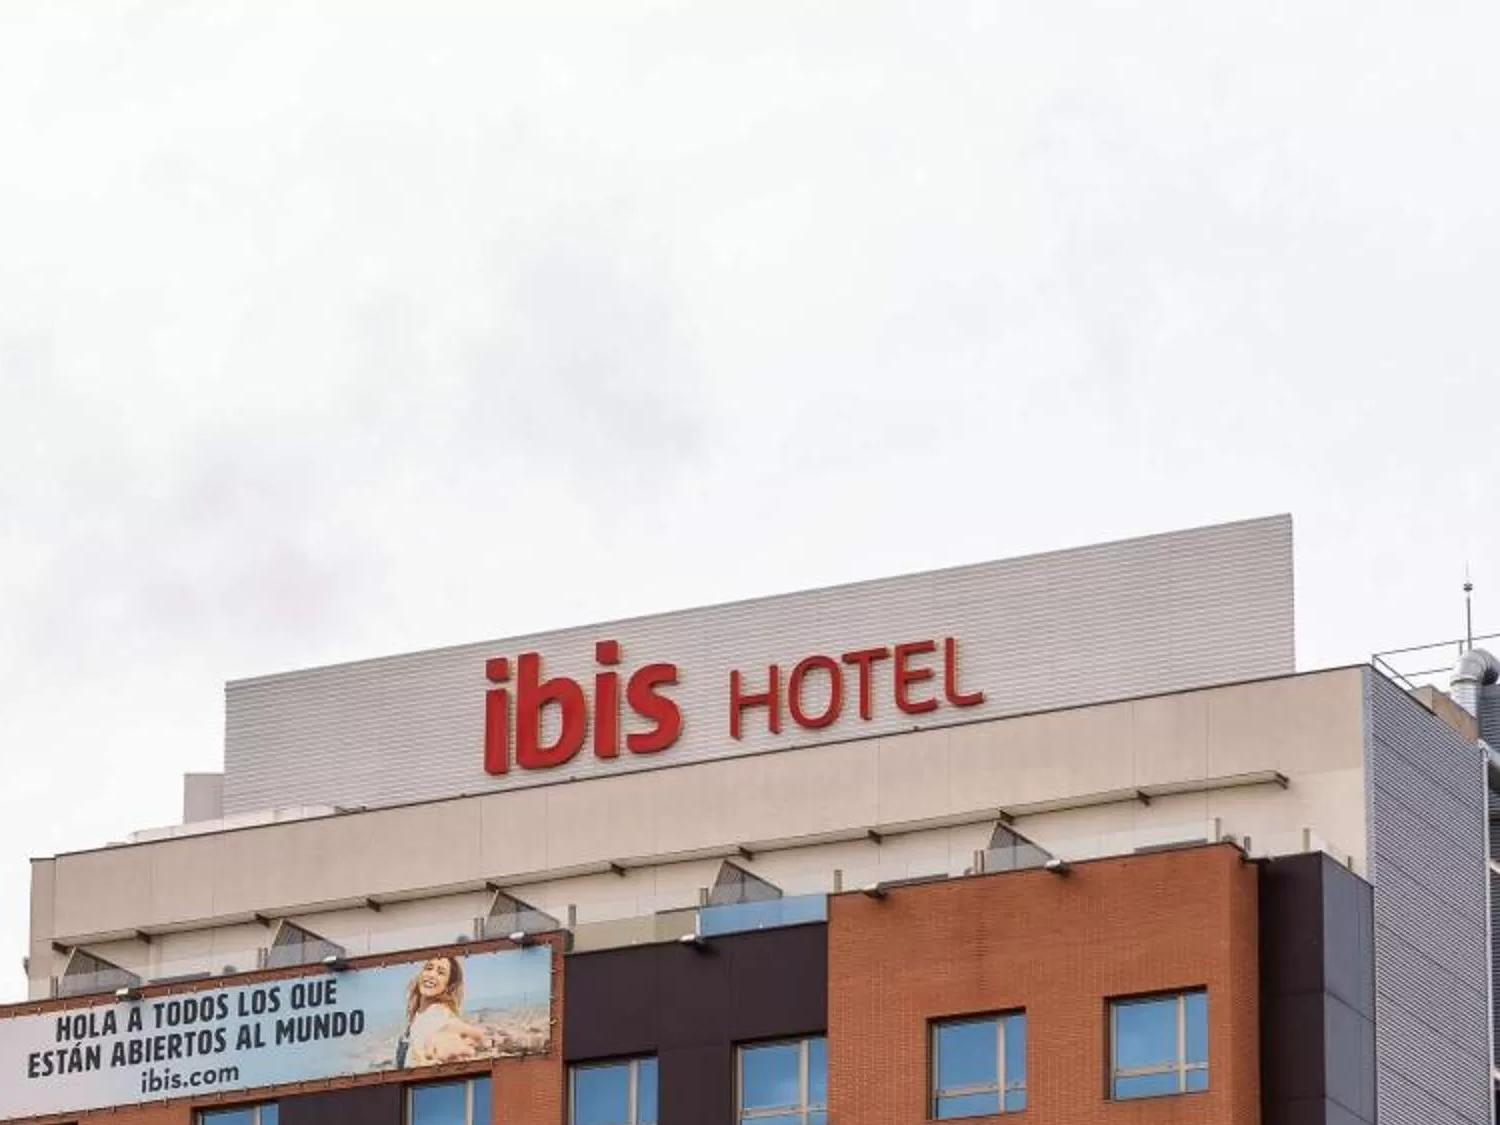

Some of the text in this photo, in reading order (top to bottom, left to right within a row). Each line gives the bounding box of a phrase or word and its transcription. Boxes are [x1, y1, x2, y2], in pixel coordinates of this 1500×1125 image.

[484, 637, 985, 776] ibis HOTEL
[56, 979, 337, 1042] HOLA A TODOS LOS QUE
[28, 1010, 365, 1078] ESTÁN ABIERTOS AL MUNDO
[141, 1065, 239, 1094] ibis.com
